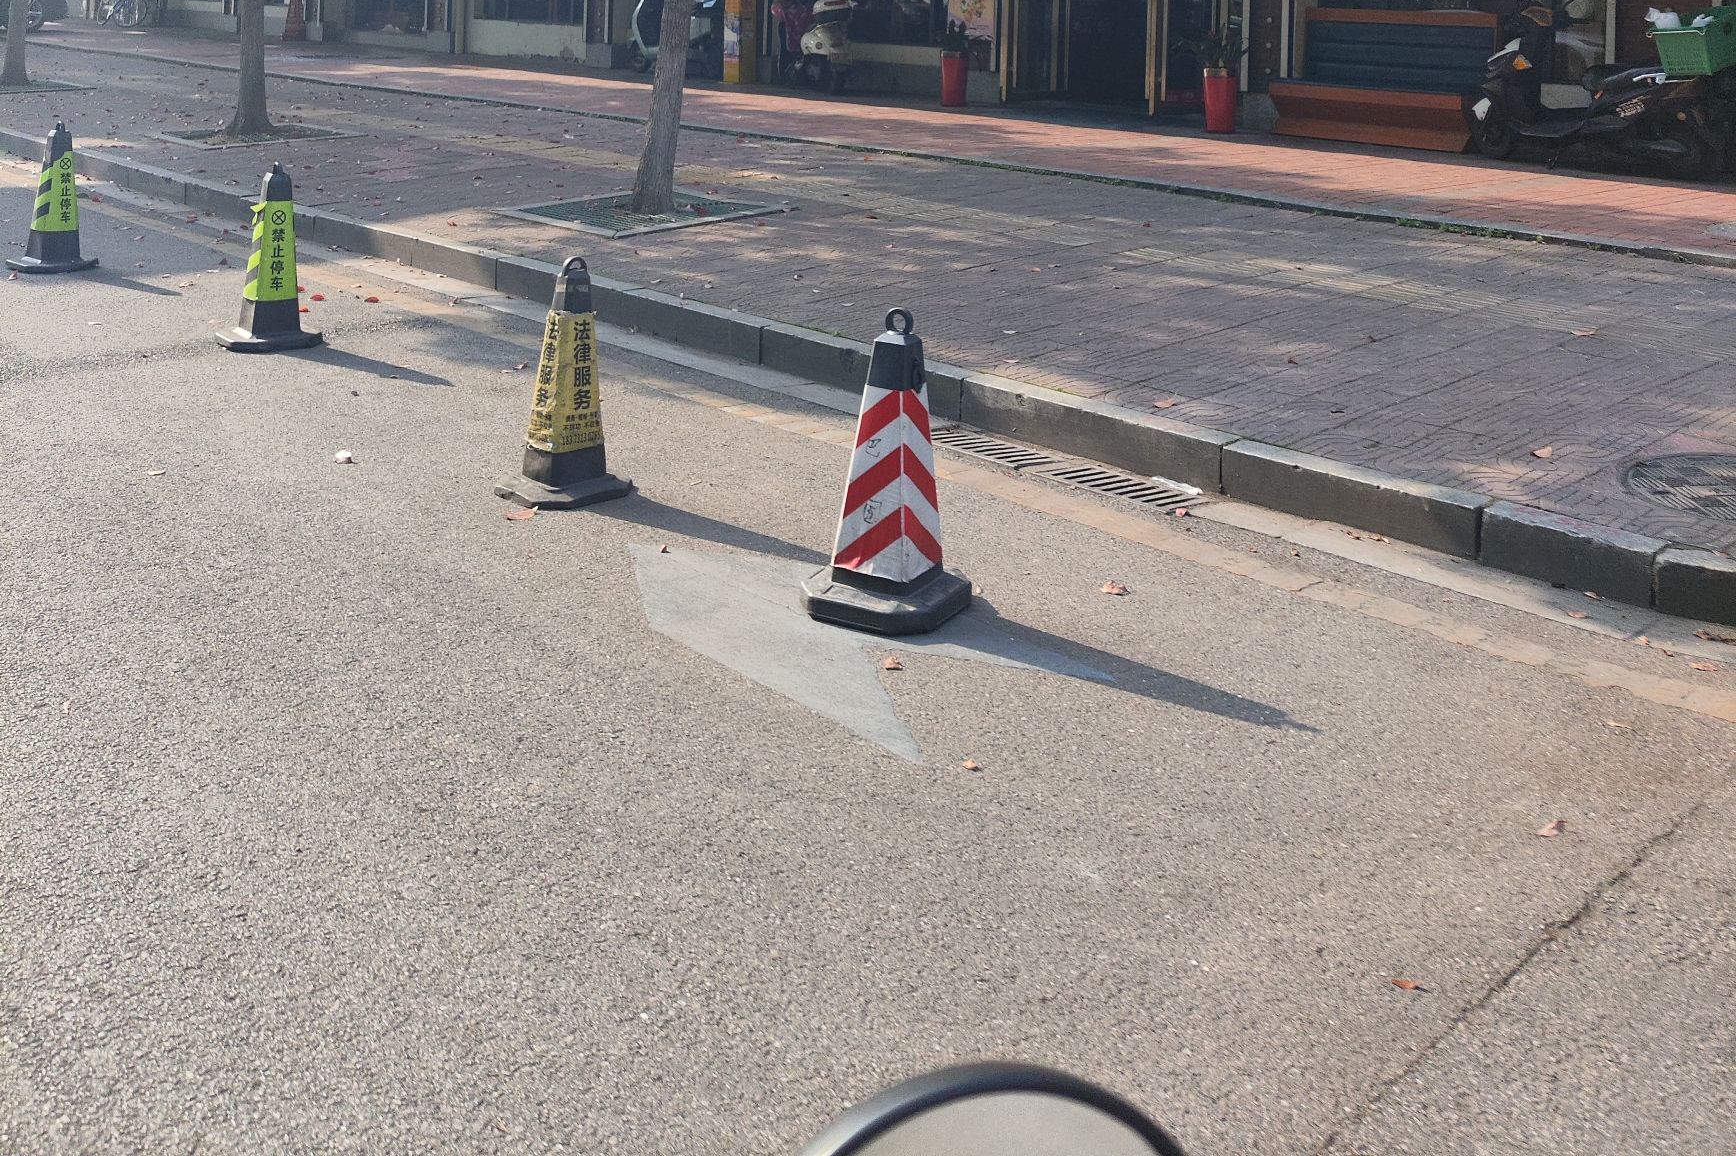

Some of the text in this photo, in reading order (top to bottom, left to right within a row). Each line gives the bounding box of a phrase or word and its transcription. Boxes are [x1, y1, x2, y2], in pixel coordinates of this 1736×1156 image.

[59, 172, 72, 224] 禁止停车
[270, 227, 286, 291] 禁止停车
[573, 318, 592, 411] 法律服务
